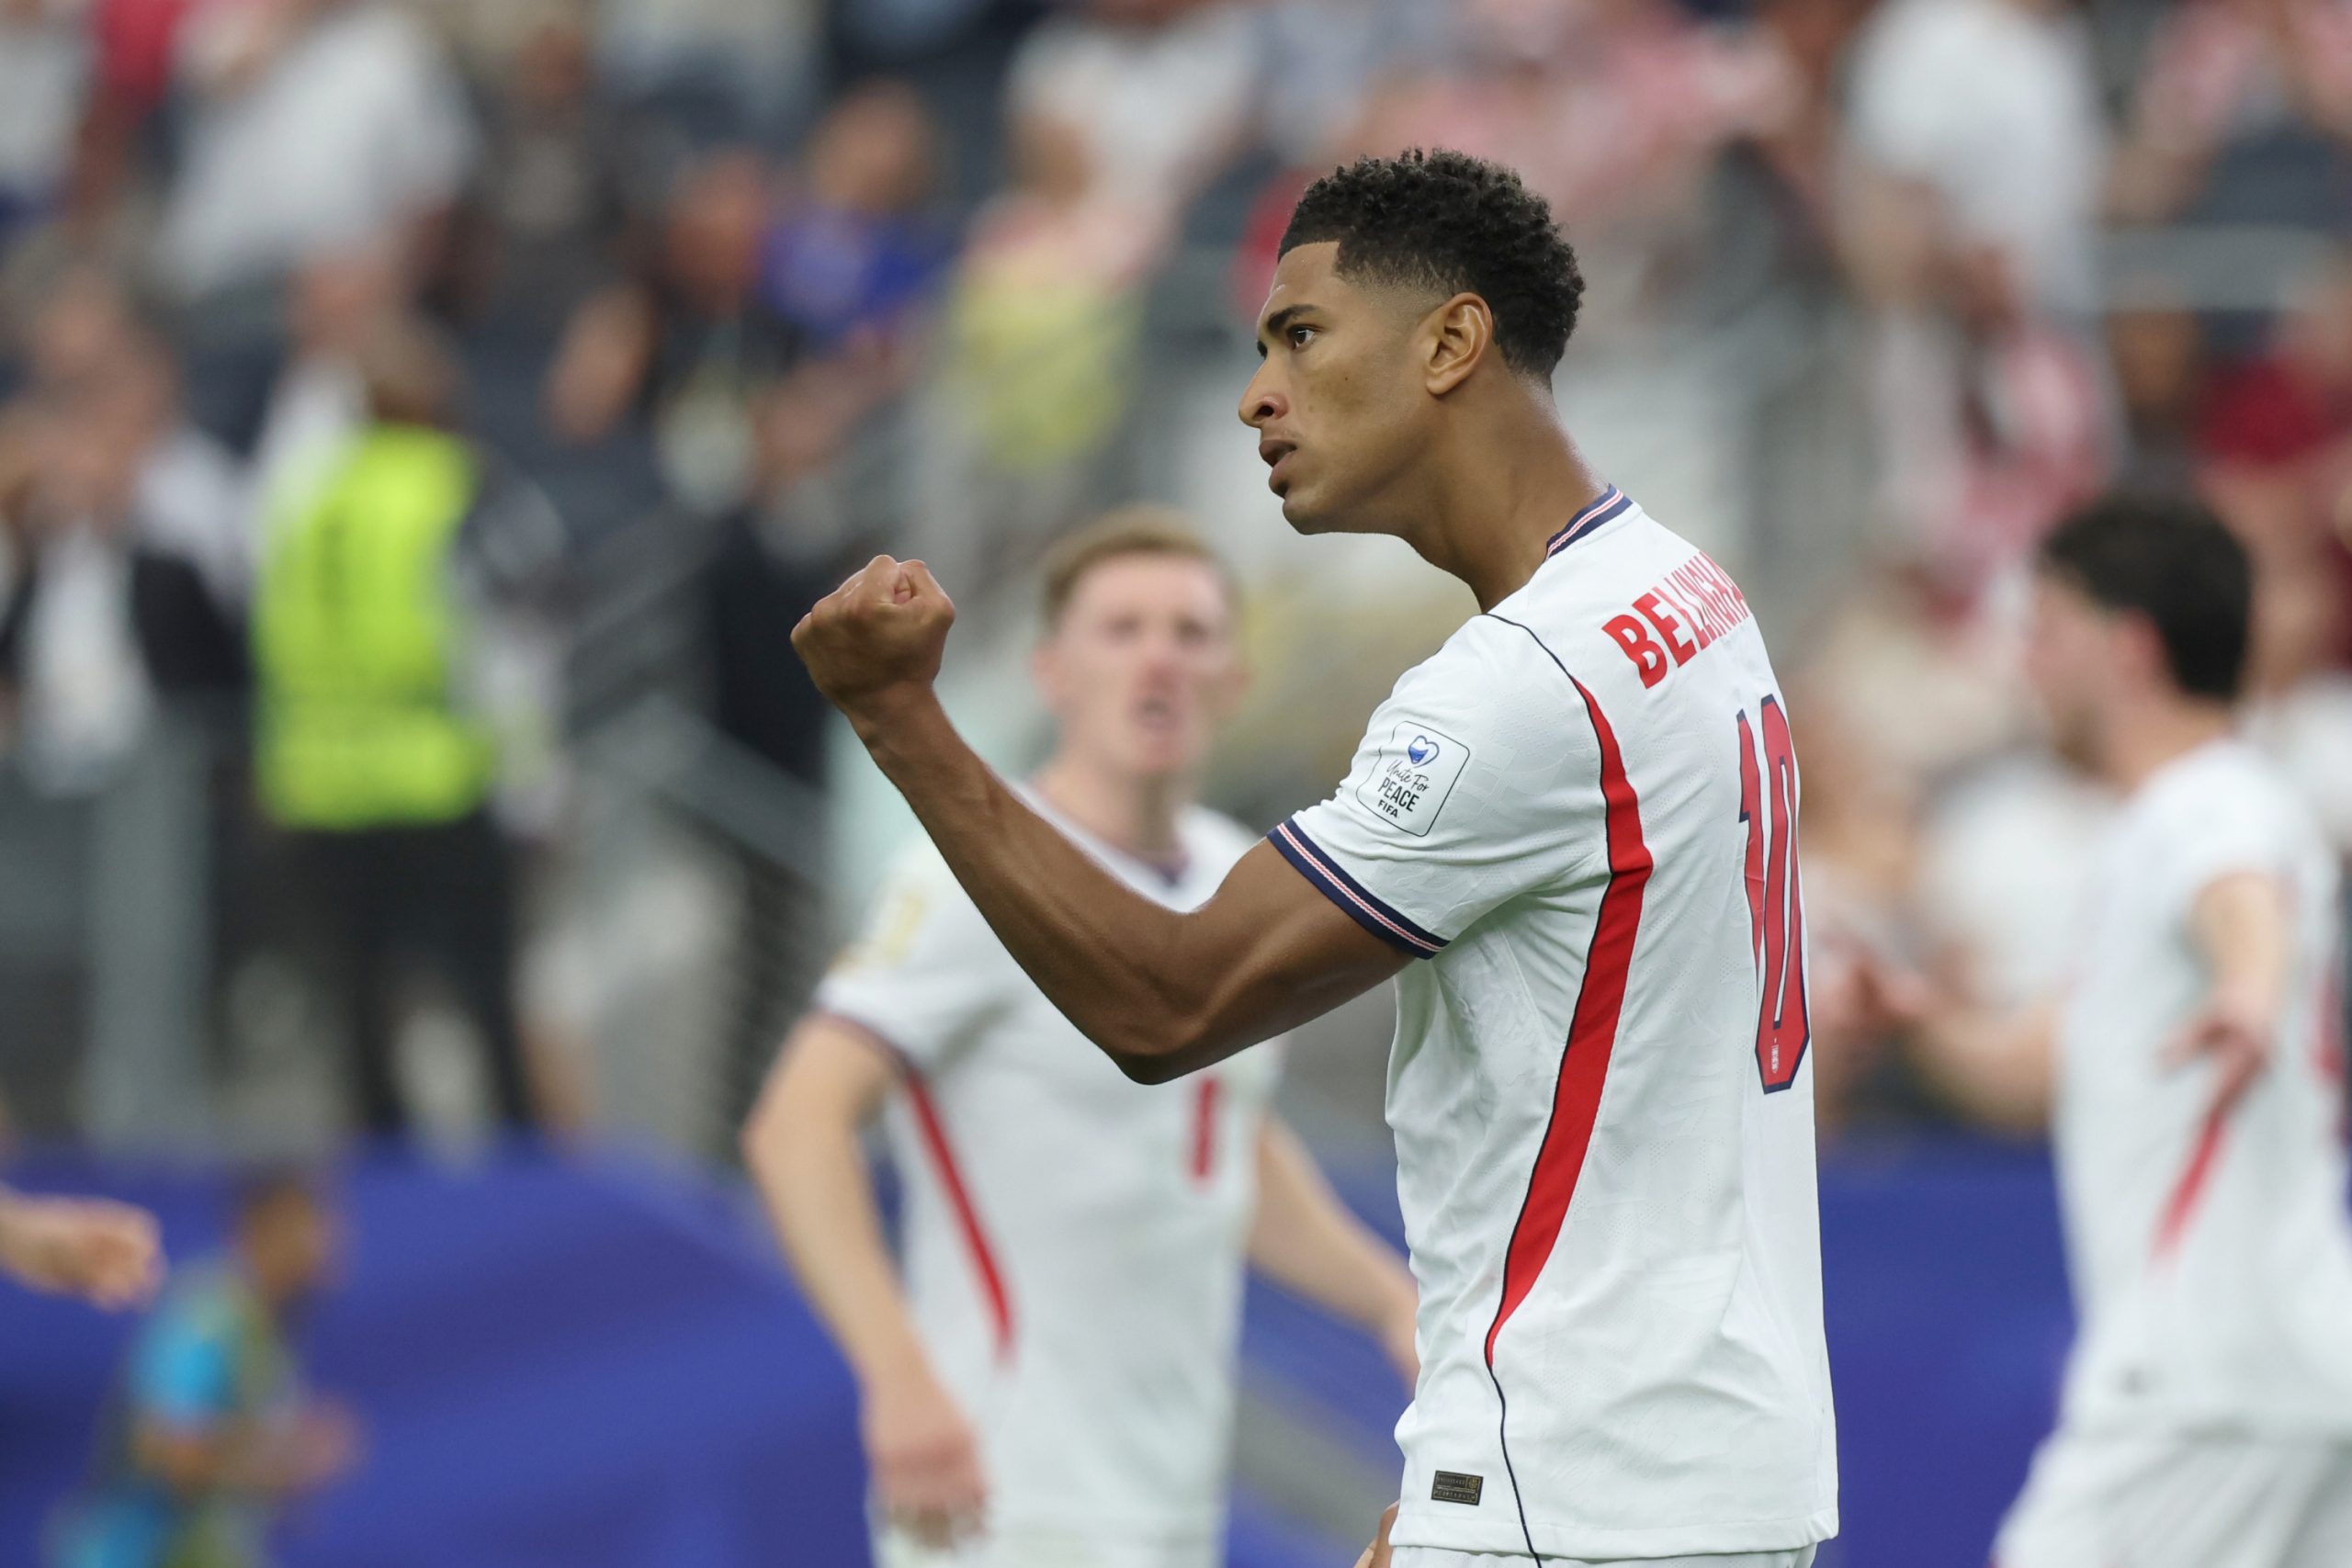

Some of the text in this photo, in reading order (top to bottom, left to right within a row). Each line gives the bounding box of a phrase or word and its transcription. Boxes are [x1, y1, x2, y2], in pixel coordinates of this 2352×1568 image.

[1386, 759, 1430, 792] Unite For
[1377, 799, 1398, 818] FIFA
[1378, 776, 1419, 812] PEACE
[1738, 694, 1810, 1095] 10
